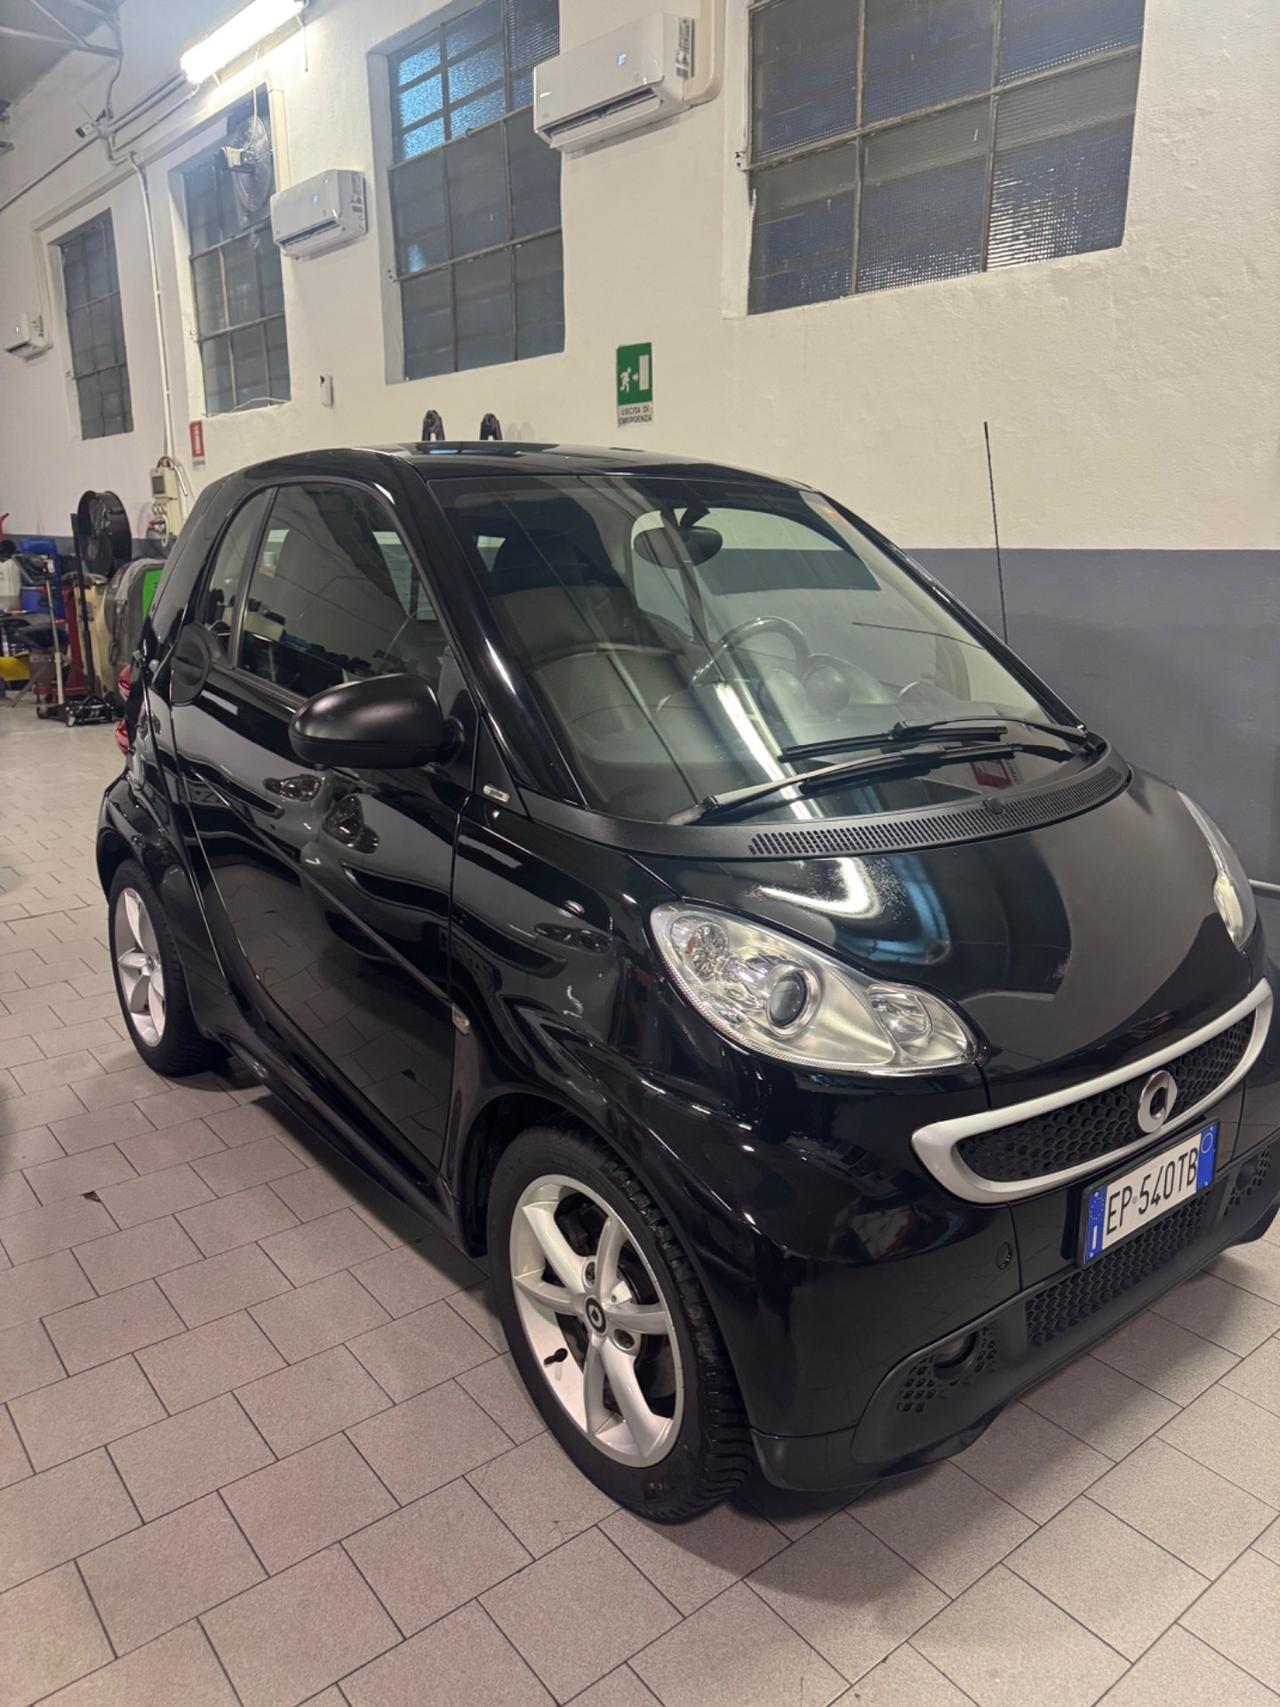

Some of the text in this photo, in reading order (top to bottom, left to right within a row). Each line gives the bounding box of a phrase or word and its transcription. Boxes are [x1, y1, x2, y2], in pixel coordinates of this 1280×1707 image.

[620, 406, 641, 416] USCITA
[618, 414, 652, 425] EMERGENZA
[1106, 1185, 1133, 1235] EP
